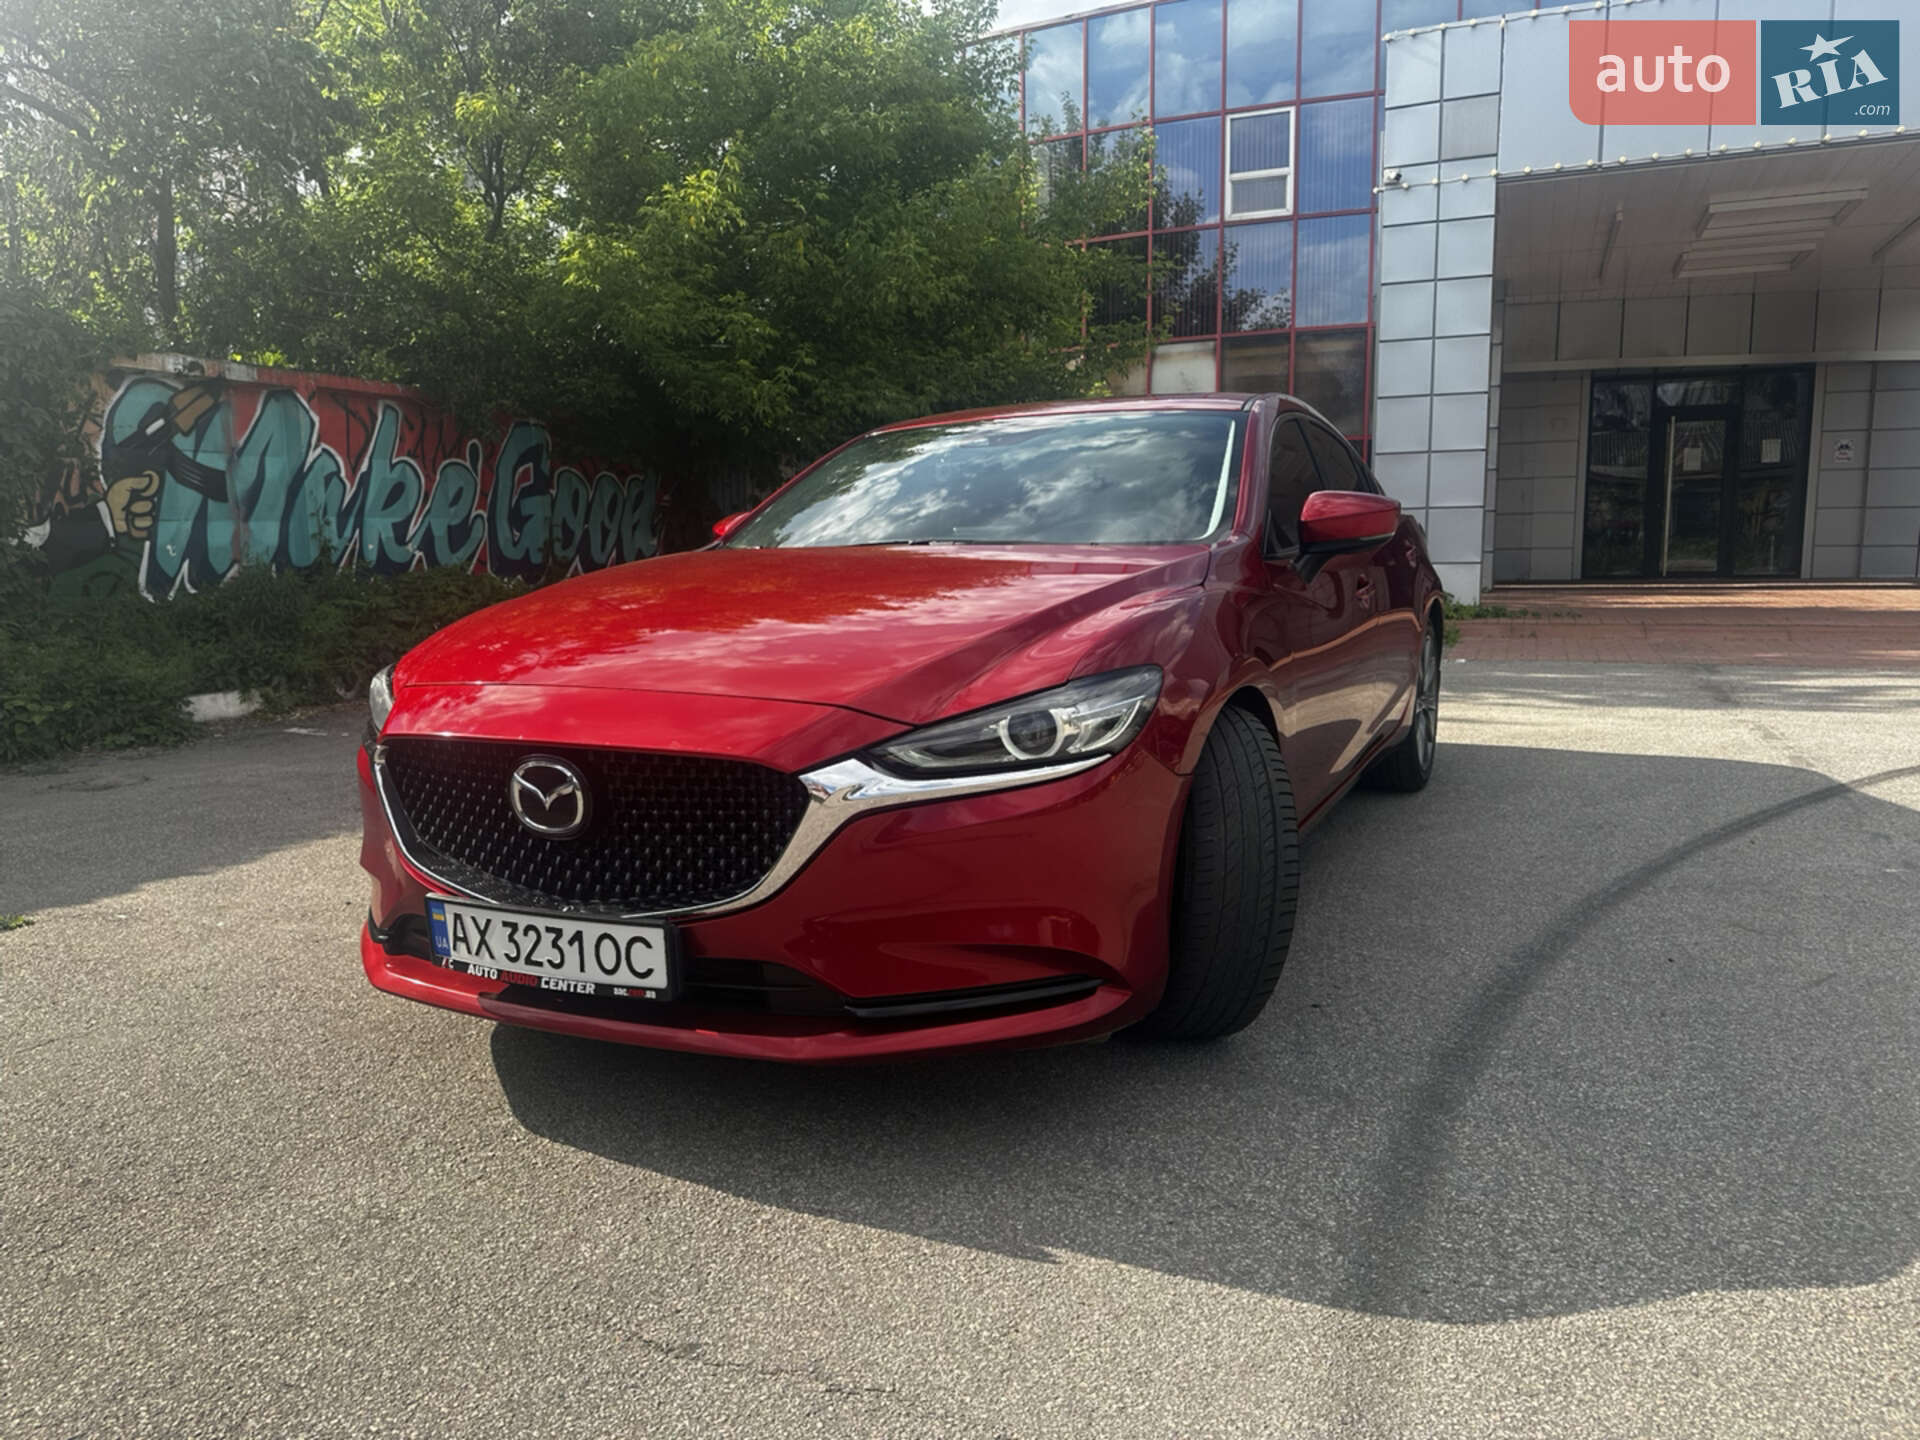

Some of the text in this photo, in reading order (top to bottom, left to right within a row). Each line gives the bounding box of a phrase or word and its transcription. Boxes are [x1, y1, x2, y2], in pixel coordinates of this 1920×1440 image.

[435, 936, 449, 950] UA
[467, 963, 498, 980] AUTO
[540, 976, 596, 995] CENTER
